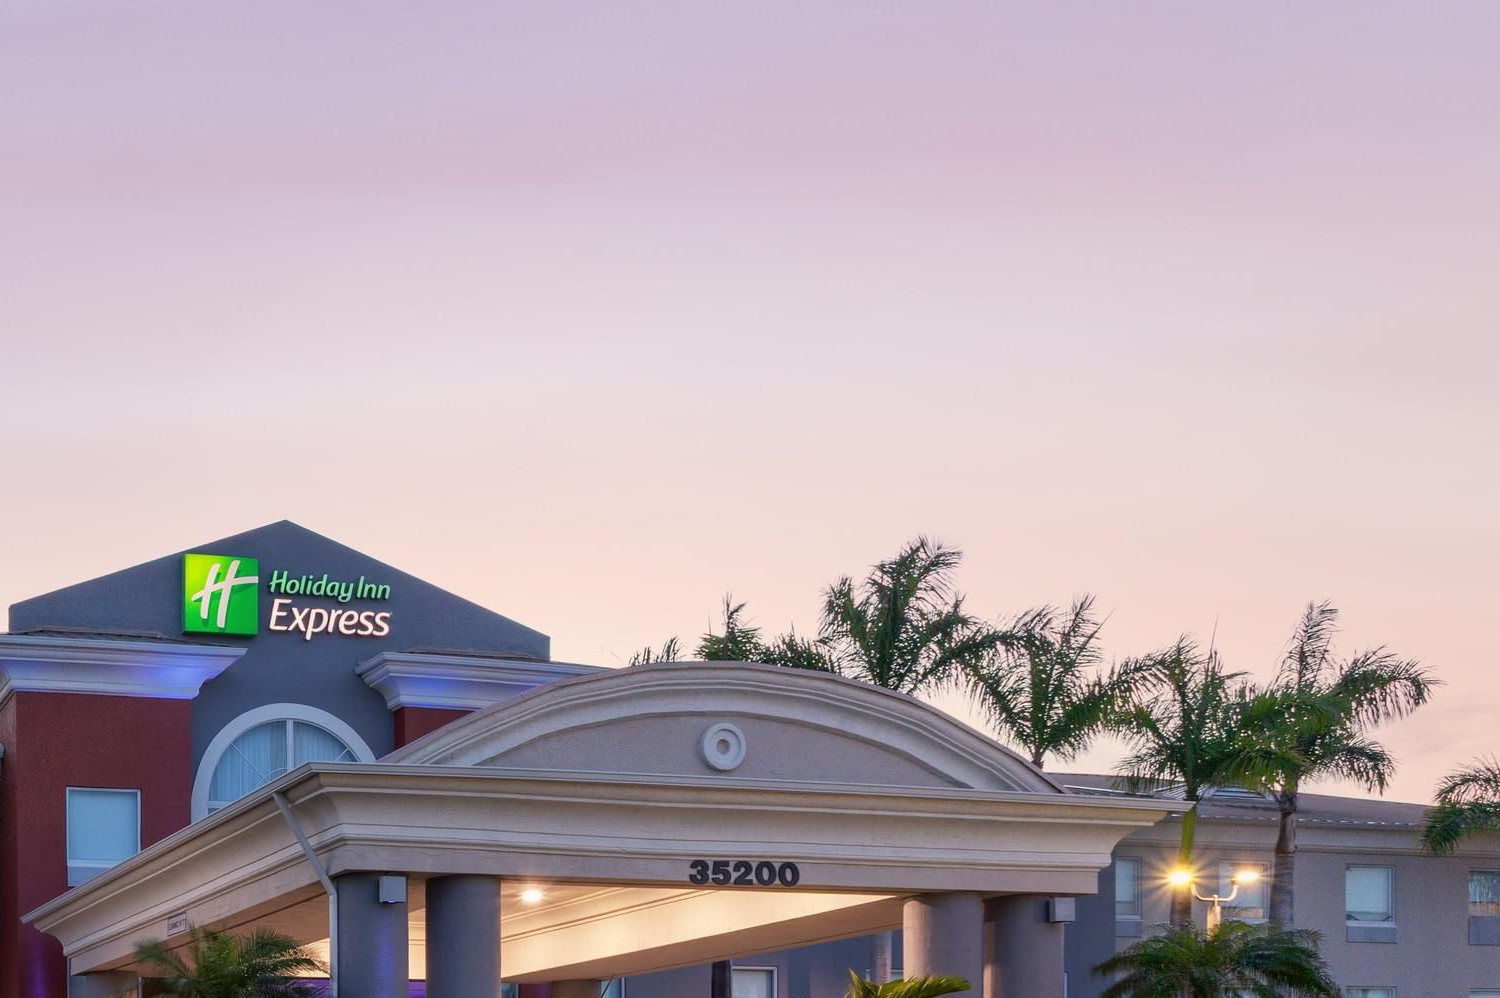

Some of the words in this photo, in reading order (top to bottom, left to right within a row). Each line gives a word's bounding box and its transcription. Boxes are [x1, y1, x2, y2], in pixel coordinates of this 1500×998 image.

[269, 570, 353, 602] Holiday
[356, 576, 390, 599] Inn
[269, 599, 390, 640] Express
[689, 860, 800, 887] 35200
